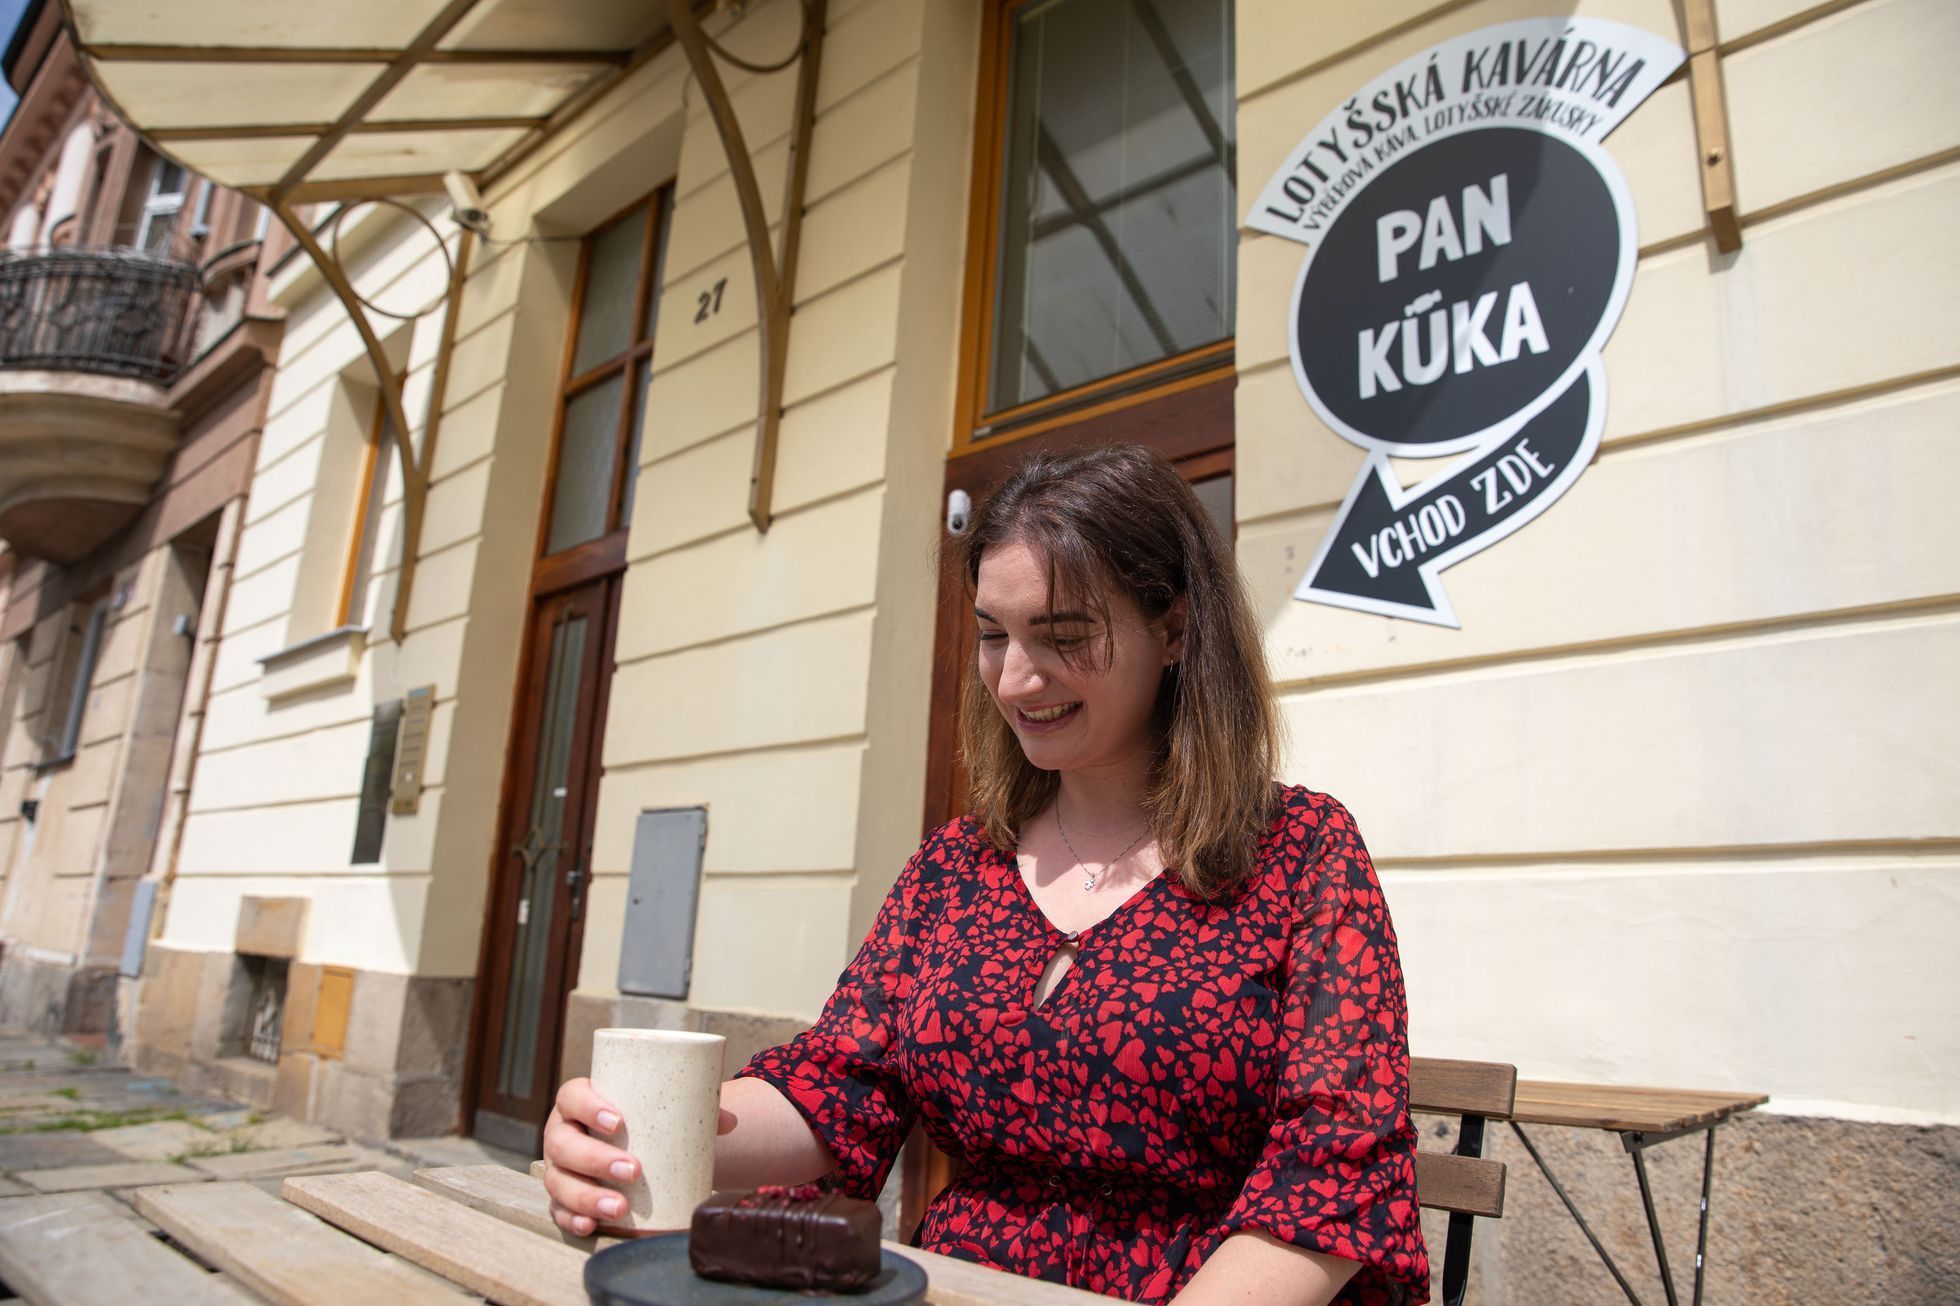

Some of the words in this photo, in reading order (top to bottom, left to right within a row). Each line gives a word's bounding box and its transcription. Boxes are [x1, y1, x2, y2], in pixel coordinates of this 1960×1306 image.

[1265, 52, 1446, 224] LOTYŠSKÁ
[1462, 26, 1647, 109] KAVÁRNA
[1376, 172, 1513, 284] PAN
[693, 276, 729, 325] 27
[1358, 280, 1551, 400] KŪKA
[1350, 494, 1467, 579] VCHOD
[1469, 437, 1556, 516] ZDE
